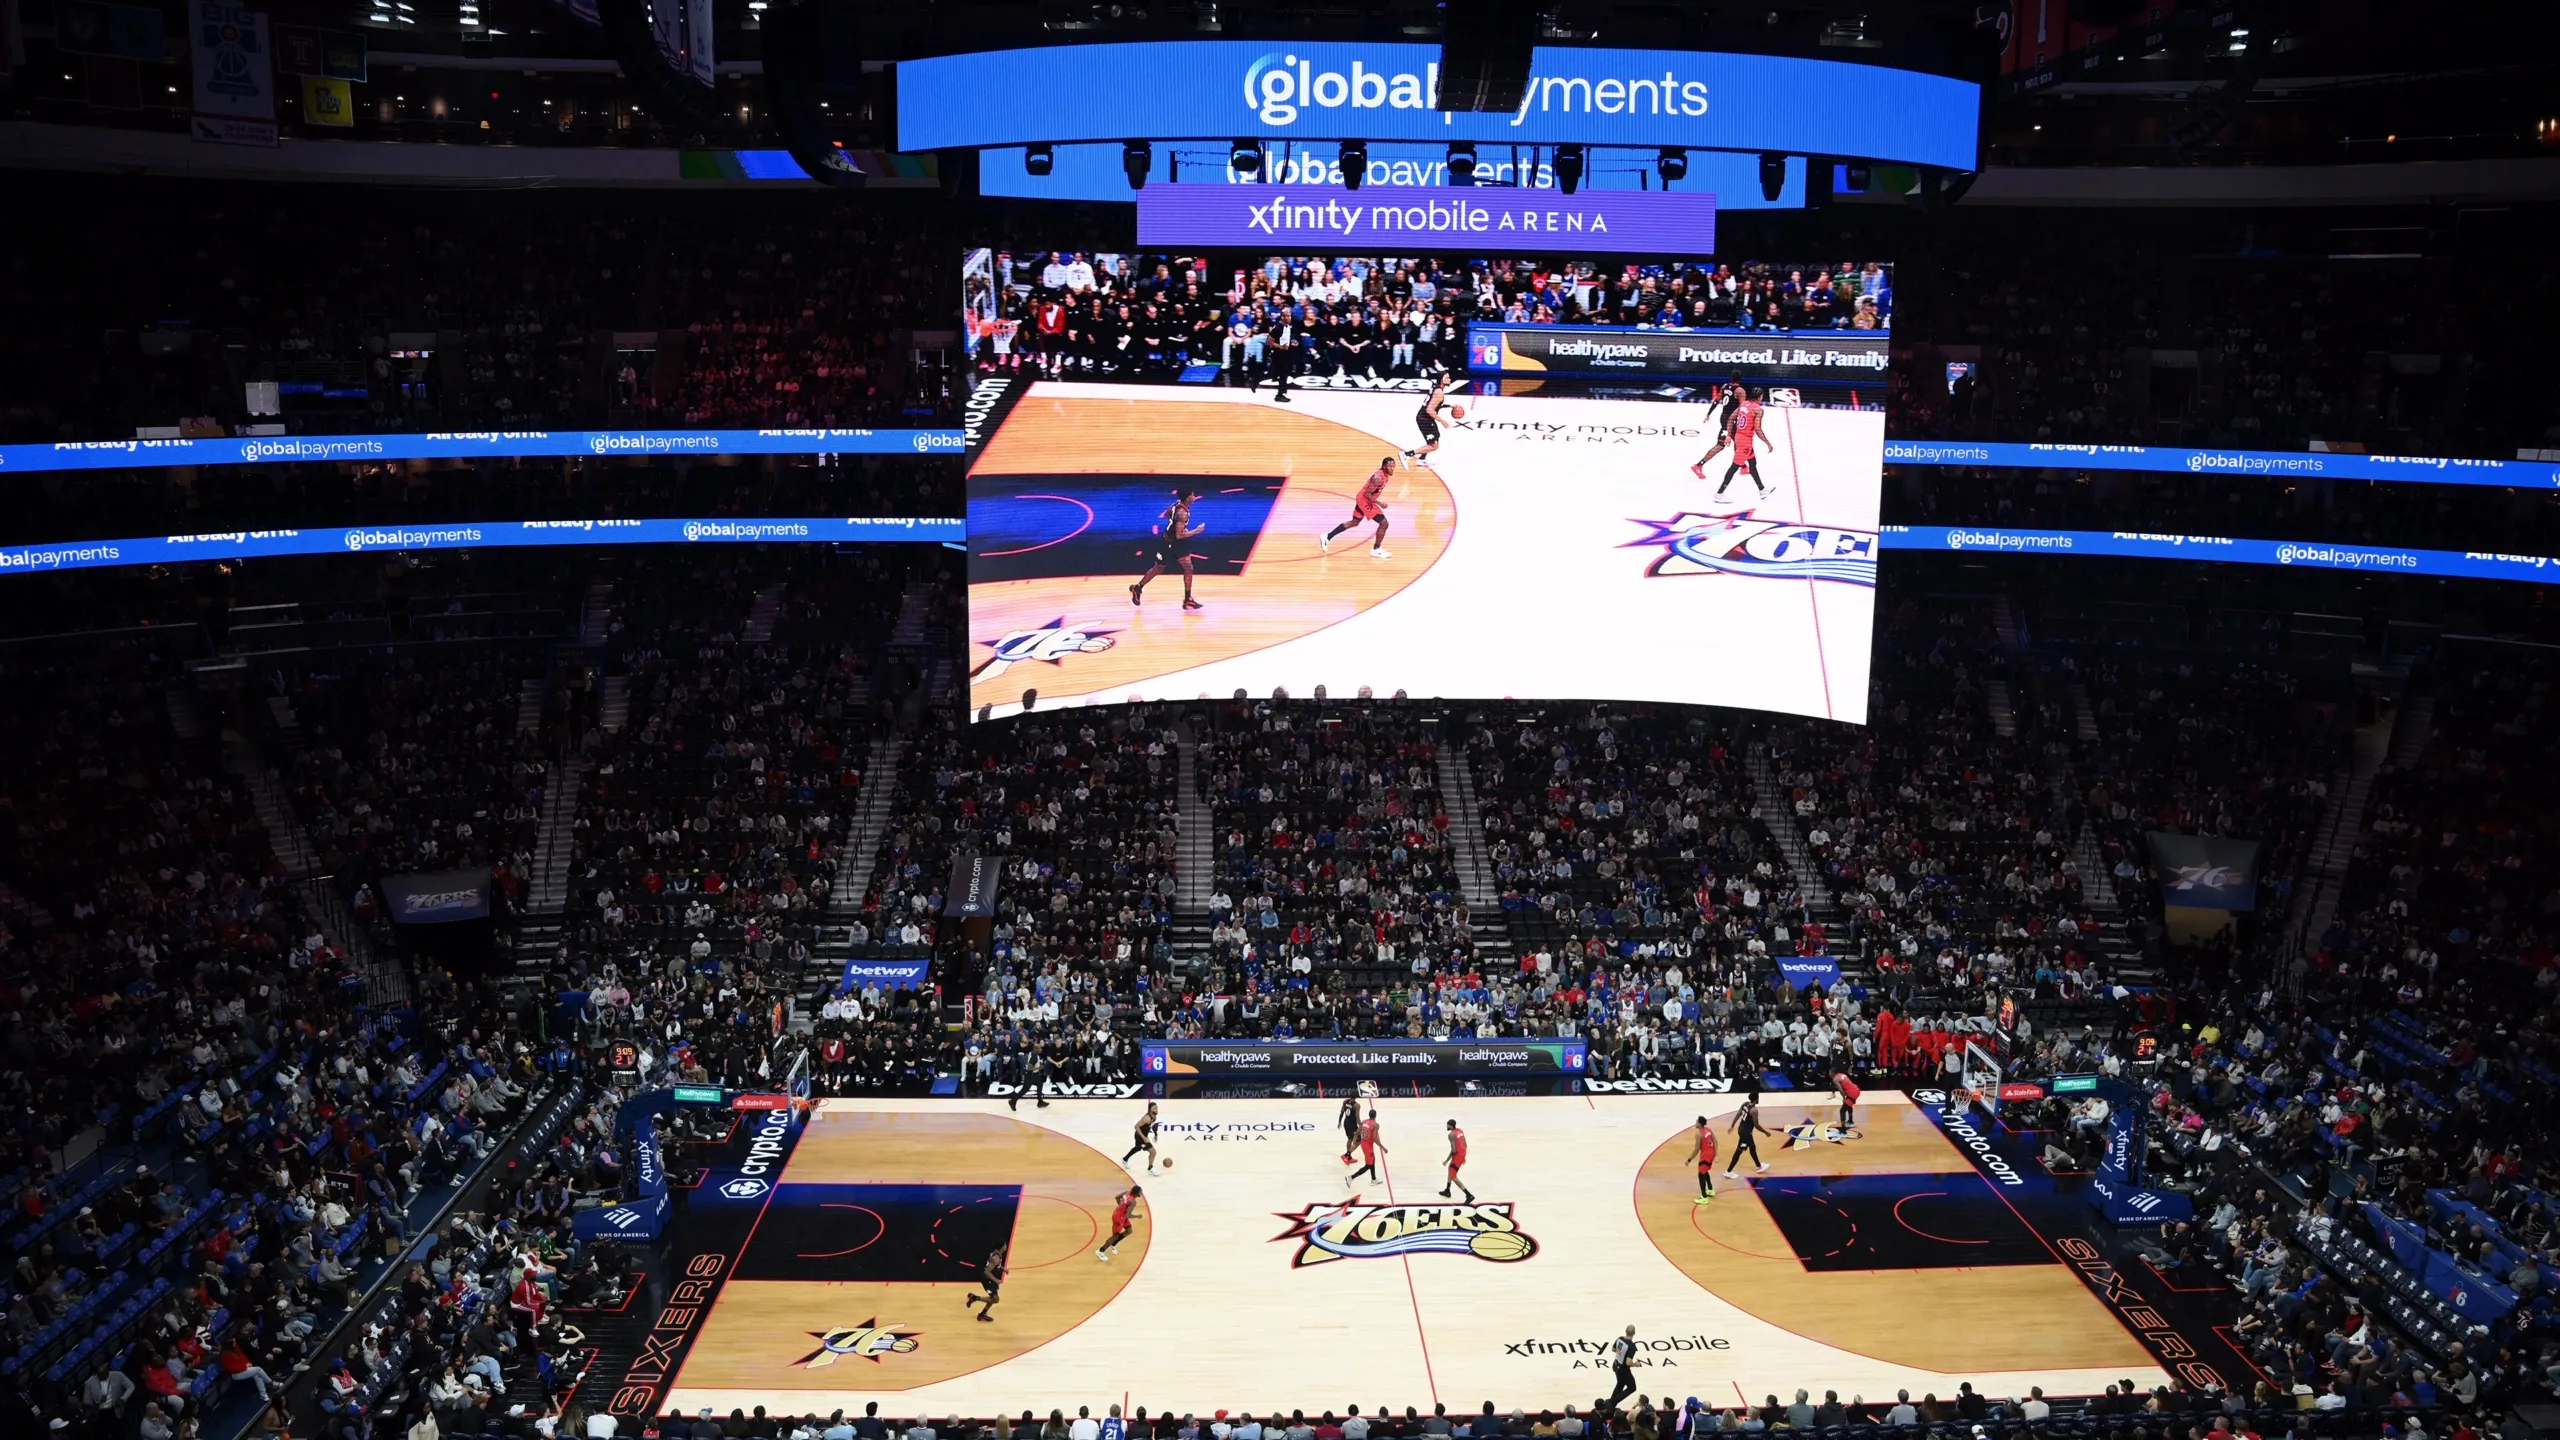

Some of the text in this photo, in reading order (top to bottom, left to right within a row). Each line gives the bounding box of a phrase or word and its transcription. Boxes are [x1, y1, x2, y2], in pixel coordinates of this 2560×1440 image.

[202, 4, 256, 25] BIG
[1258, 59, 1709, 126] globalyments
[1240, 150, 1554, 188] lobapayents
[1248, 195, 1608, 235] xfinity mobile ARENA
[1472, 346, 1498, 364] 76
[1549, 339, 1648, 359] healthypaws
[1679, 347, 1776, 366] Protected.
[1780, 349, 1821, 367] Like
[1452, 419, 1700, 438] xfinity mobile
[594, 433, 718, 454] globalpayments
[1516, 434, 1630, 444] ARENA
[246, 440, 383, 461] globalpayments
[1884, 444, 1989, 462] obalpayments
[2190, 452, 2323, 472] globalpayments
[349, 530, 481, 551] globalpayments
[686, 521, 808, 541] globalpayments
[1950, 530, 2073, 549] globalpayments
[2280, 545, 2417, 568] globalpayments
[967, 857, 983, 902] crypto.com
[404, 888, 479, 914] 76ERS
[850, 965, 920, 977] betway
[1781, 963, 1833, 973] betway
[1145, 1057, 1163, 1071] 76
[1200, 1050, 1271, 1067] healthypaws
[1293, 1052, 1437, 1067] Protected. Like Family.
[1459, 1049, 1528, 1065] healthypaws
[1565, 1056, 1583, 1068] 76
[1583, 1077, 1734, 1093] betway
[1228, 1120, 1315, 1132] mobile
[740, 1108, 788, 1175] crypto.co
[1184, 1134, 1267, 1142] ARENA
[2113, 1129, 2130, 1171] xfinity
[638, 1140, 654, 1183] xfinity
[1302, 1203, 1516, 1265] 76ERS
[2056, 1237, 2228, 1391] SIXERS
[608, 1253, 725, 1416] SIXERS
[1504, 1338, 1608, 1357] xfinity
[1572, 1357, 1678, 1369] ARNA
[1105, 1428, 1118, 1440] 21
